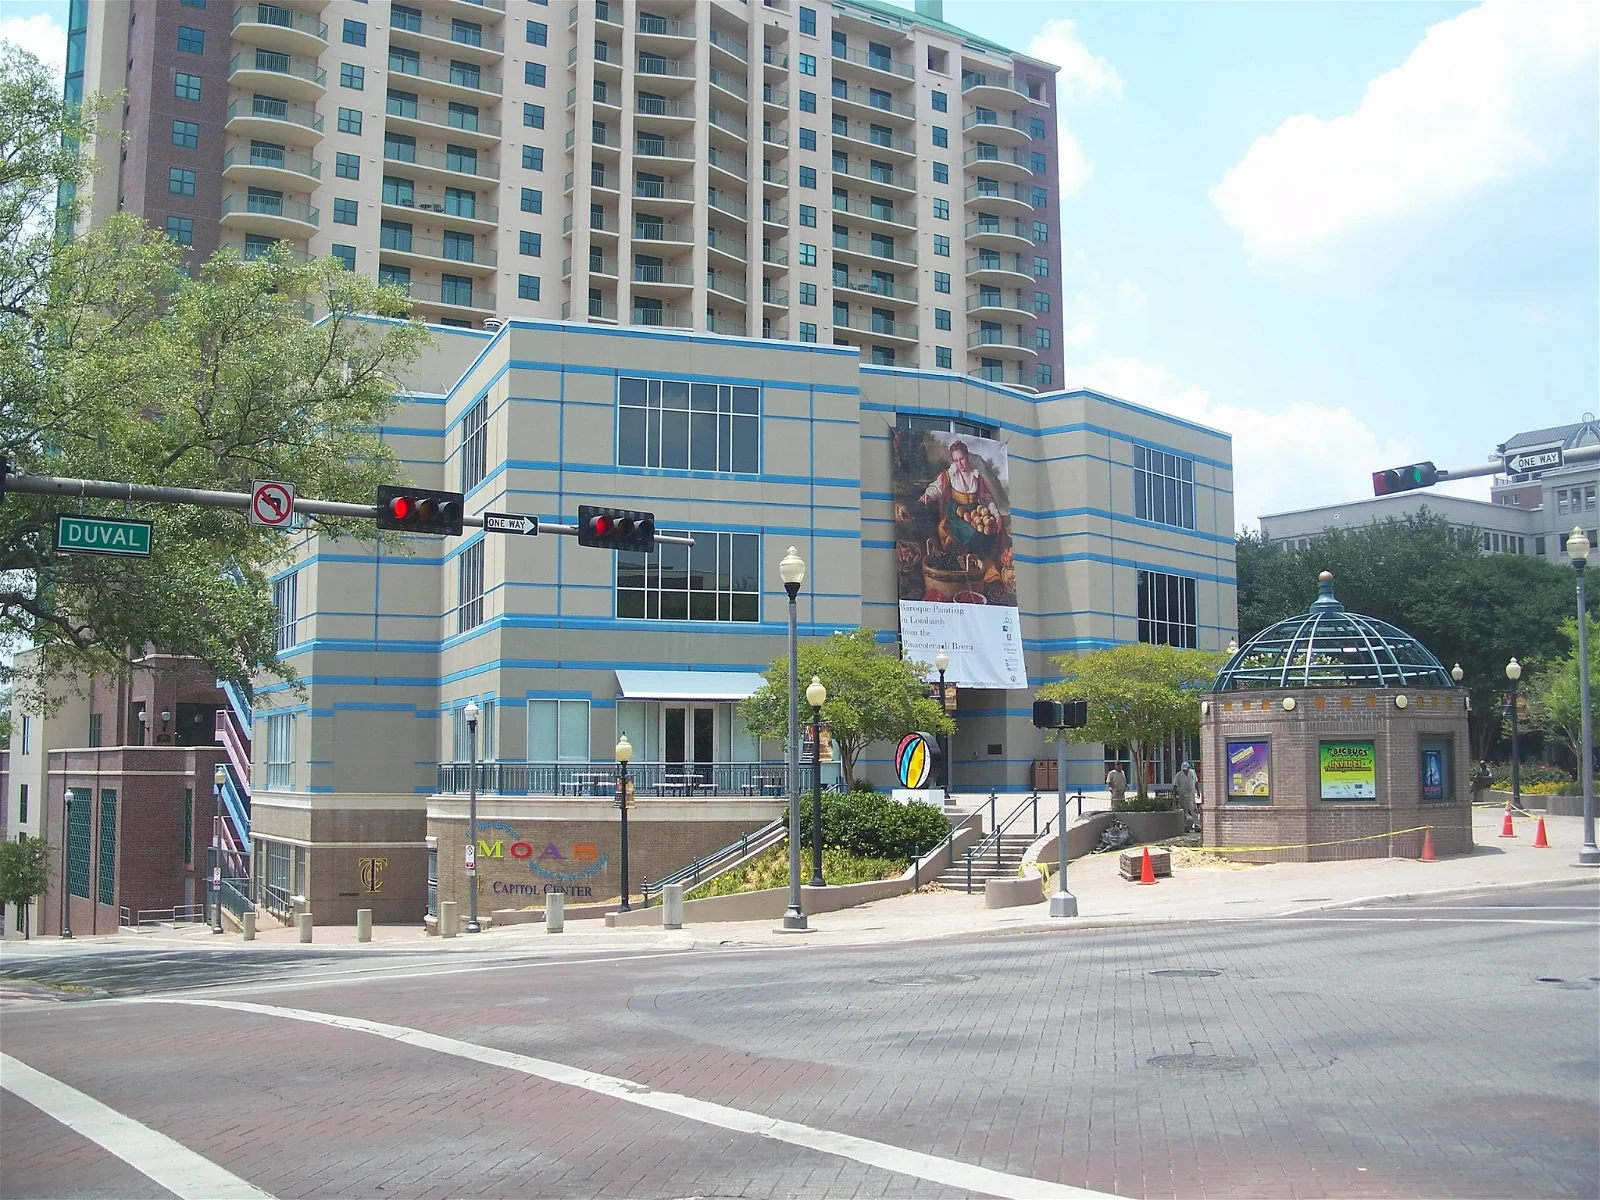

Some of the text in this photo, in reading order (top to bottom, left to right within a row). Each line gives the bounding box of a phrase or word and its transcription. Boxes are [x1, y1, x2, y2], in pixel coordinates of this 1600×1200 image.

[1519, 454, 1557, 467] ONE WAY
[489, 519, 525, 529] ONE WAY
[69, 524, 140, 546] DUVAL
[901, 603, 964, 615] Baroque Painting
[910, 616, 946, 627] Lombardy
[902, 628, 932, 637] from the
[903, 640, 941, 650] Pinacoteca
[952, 642, 974, 651] Brera
[476, 839, 598, 860] MOAS
